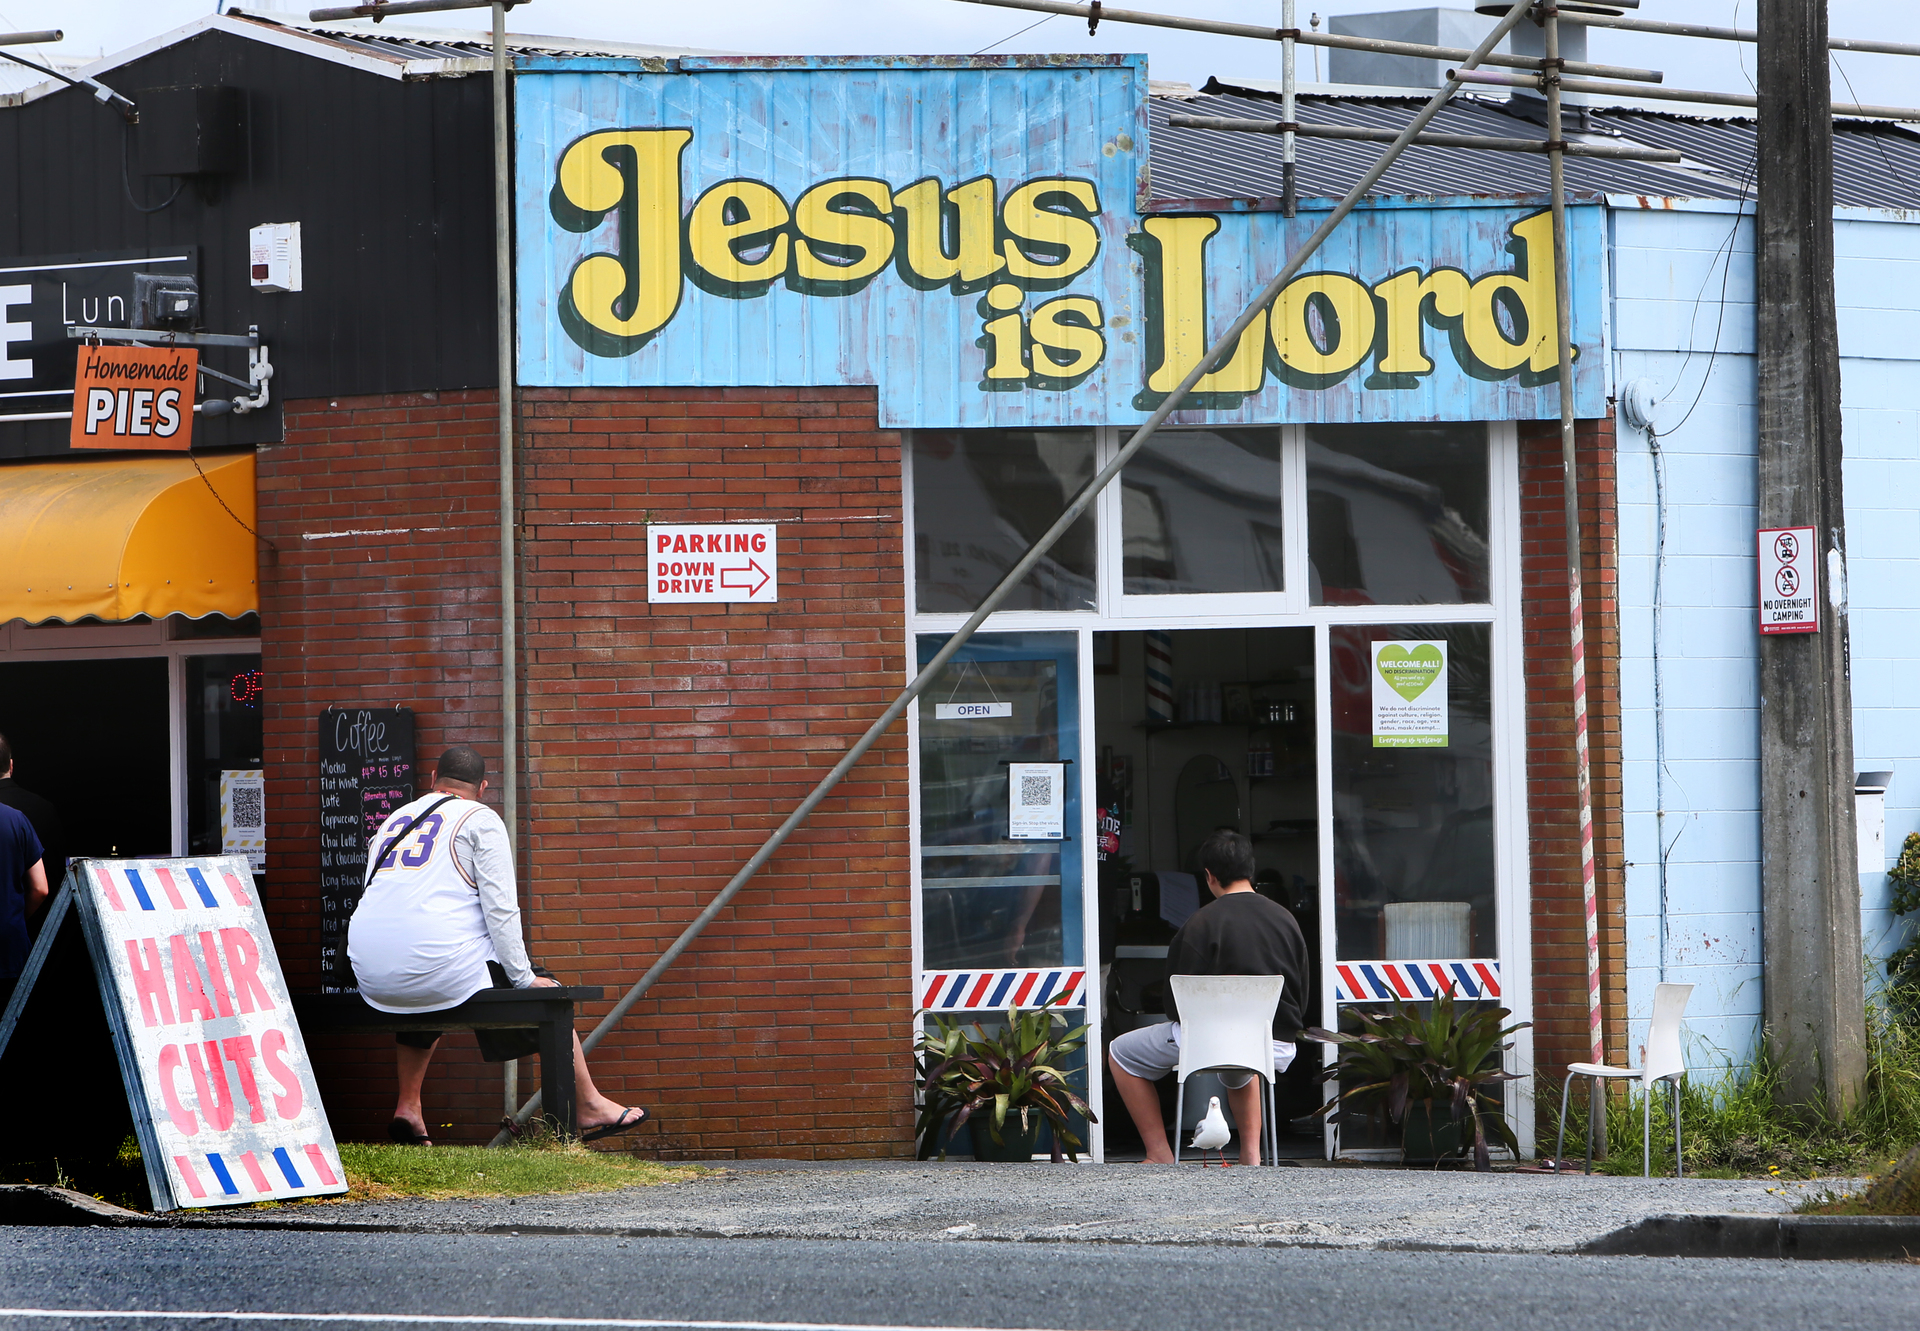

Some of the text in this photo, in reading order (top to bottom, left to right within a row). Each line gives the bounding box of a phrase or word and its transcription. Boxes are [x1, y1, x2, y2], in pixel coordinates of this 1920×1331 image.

[549, 127, 1103, 357] Jesus
[63, 281, 125, 325] Lun
[977, 207, 1580, 410] is Lord
[84, 355, 189, 382] Homemade
[84, 387, 181, 438] PIES
[657, 533, 767, 554] PARKING
[657, 562, 714, 576] DOWN
[657, 579, 714, 593] DRIVE
[1764, 598, 1812, 610] NO OVERNIGHT
[1772, 610, 1804, 621] CAMPING
[1380, 660, 1440, 668] WELCOME ALL!
[957, 705, 990, 715] OPEN
[336, 710, 389, 758] Coffee
[1378, 736, 1443, 747] Everyone is welcome
[321, 758, 346, 775] Mocha
[321, 776, 359, 790] Flat White
[321, 811, 359, 829] Cappuccino
[321, 832, 338, 848] Chai
[374, 811, 447, 873] 23
[322, 850, 333, 867] Hot
[321, 872, 339, 891] Long
[322, 895, 336, 912] Tea
[323, 917, 338, 932] Iced
[322, 946, 337, 957] Extr
[125, 927, 276, 1027] HAIR
[158, 1029, 304, 1136] CUTS
